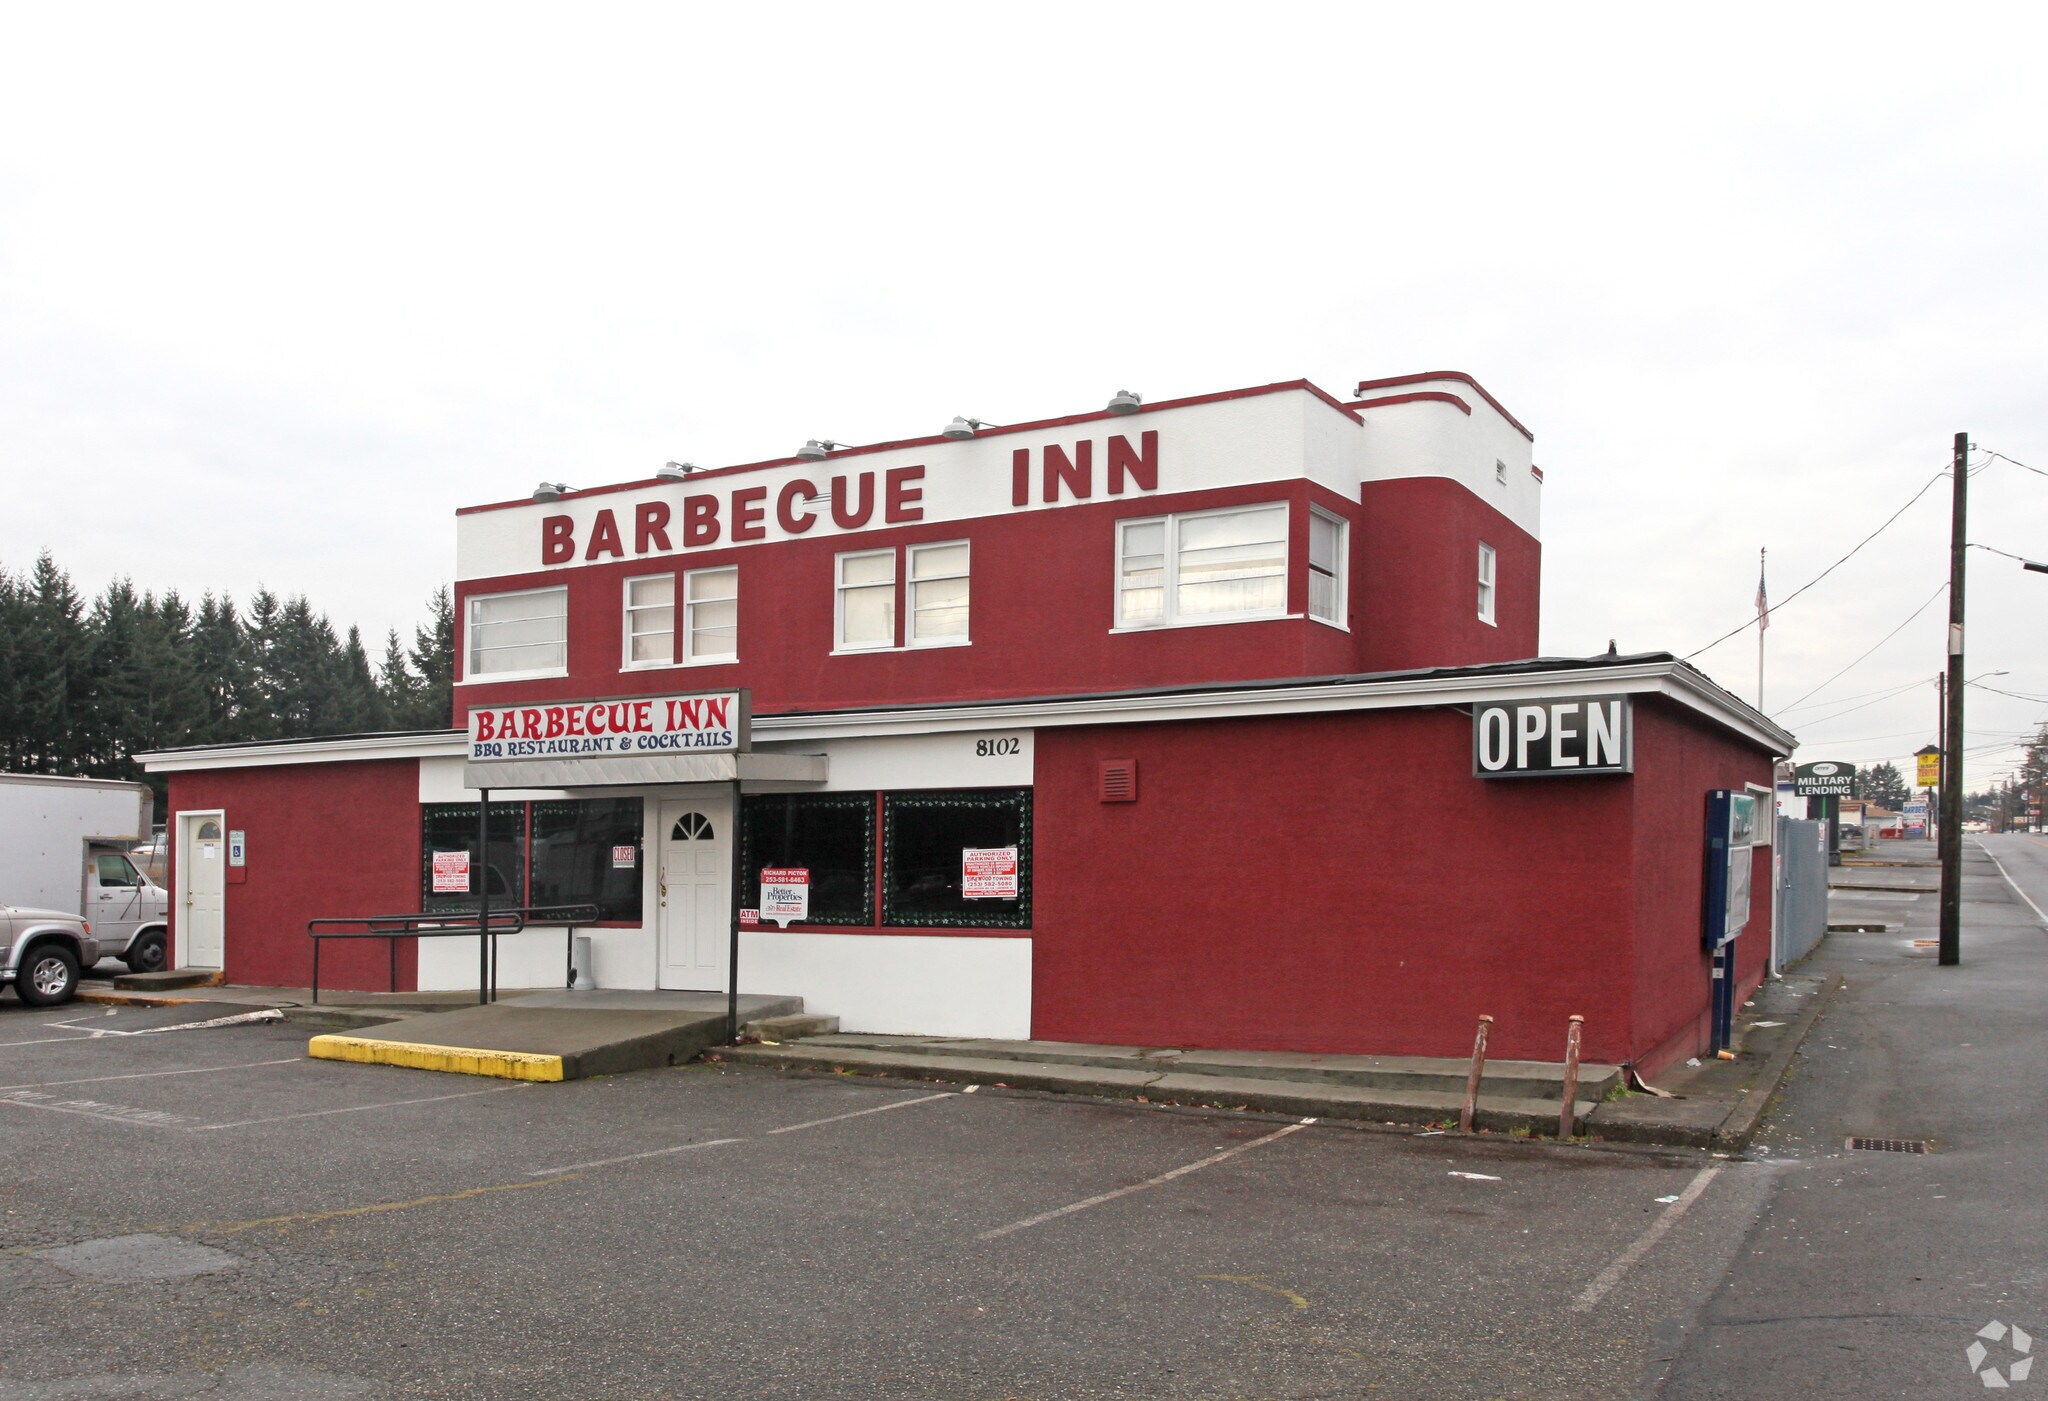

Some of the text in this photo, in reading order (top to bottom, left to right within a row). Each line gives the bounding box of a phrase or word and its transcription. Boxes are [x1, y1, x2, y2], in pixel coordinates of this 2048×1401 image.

[541, 430, 1159, 566] BARBECUE INN
[475, 697, 731, 742] BARBECUE INN
[1479, 700, 1622, 771] OPEN
[474, 730, 733, 757] BBQ RESTAURANT & COCKTAILS
[976, 737, 1021, 757] 8102
[1797, 776, 1853, 786] MILITARY
[1799, 785, 1851, 795] LENDING
[614, 847, 634, 861] CLOSED
[767, 892, 803, 902] Properties
[772, 887, 793, 895] Better
[740, 910, 759, 918] ATM
